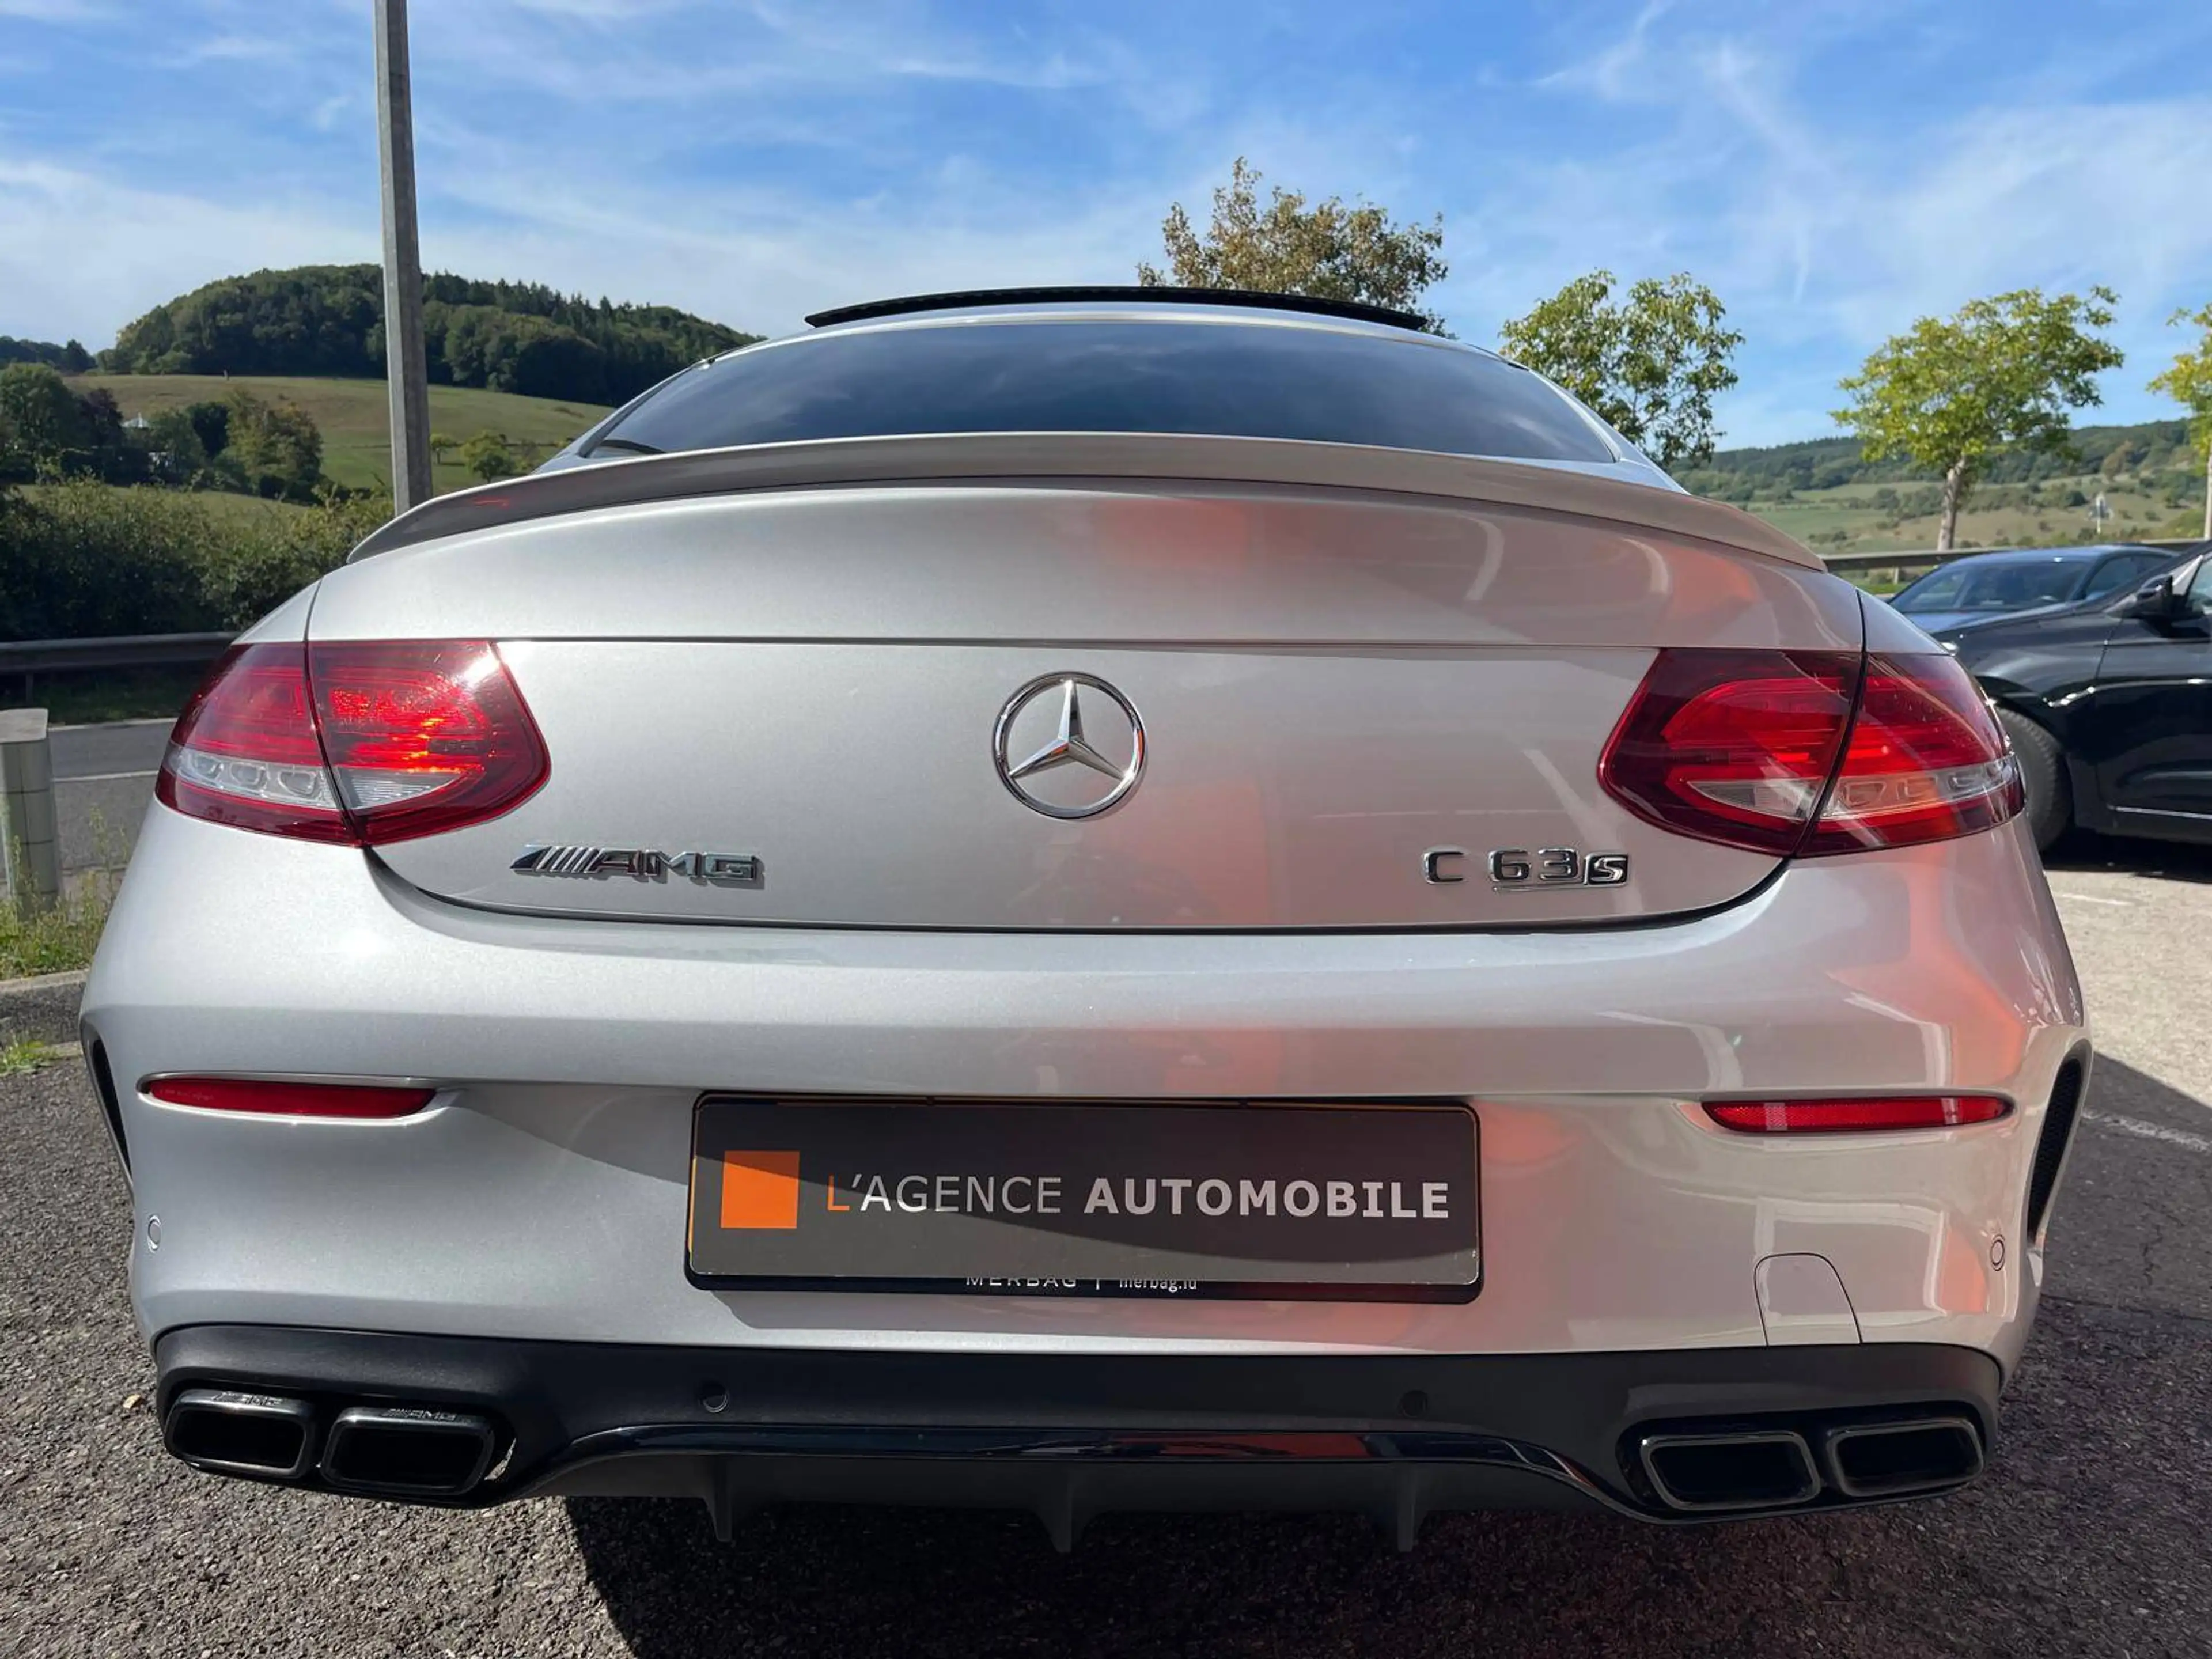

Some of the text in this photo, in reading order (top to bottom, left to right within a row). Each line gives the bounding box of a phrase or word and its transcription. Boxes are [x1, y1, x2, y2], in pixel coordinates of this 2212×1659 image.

[583, 847, 764, 881] AMG
[1423, 849, 1465, 884] C
[827, 1173, 1449, 1219] L'AGENCE AUTOMOBILE
